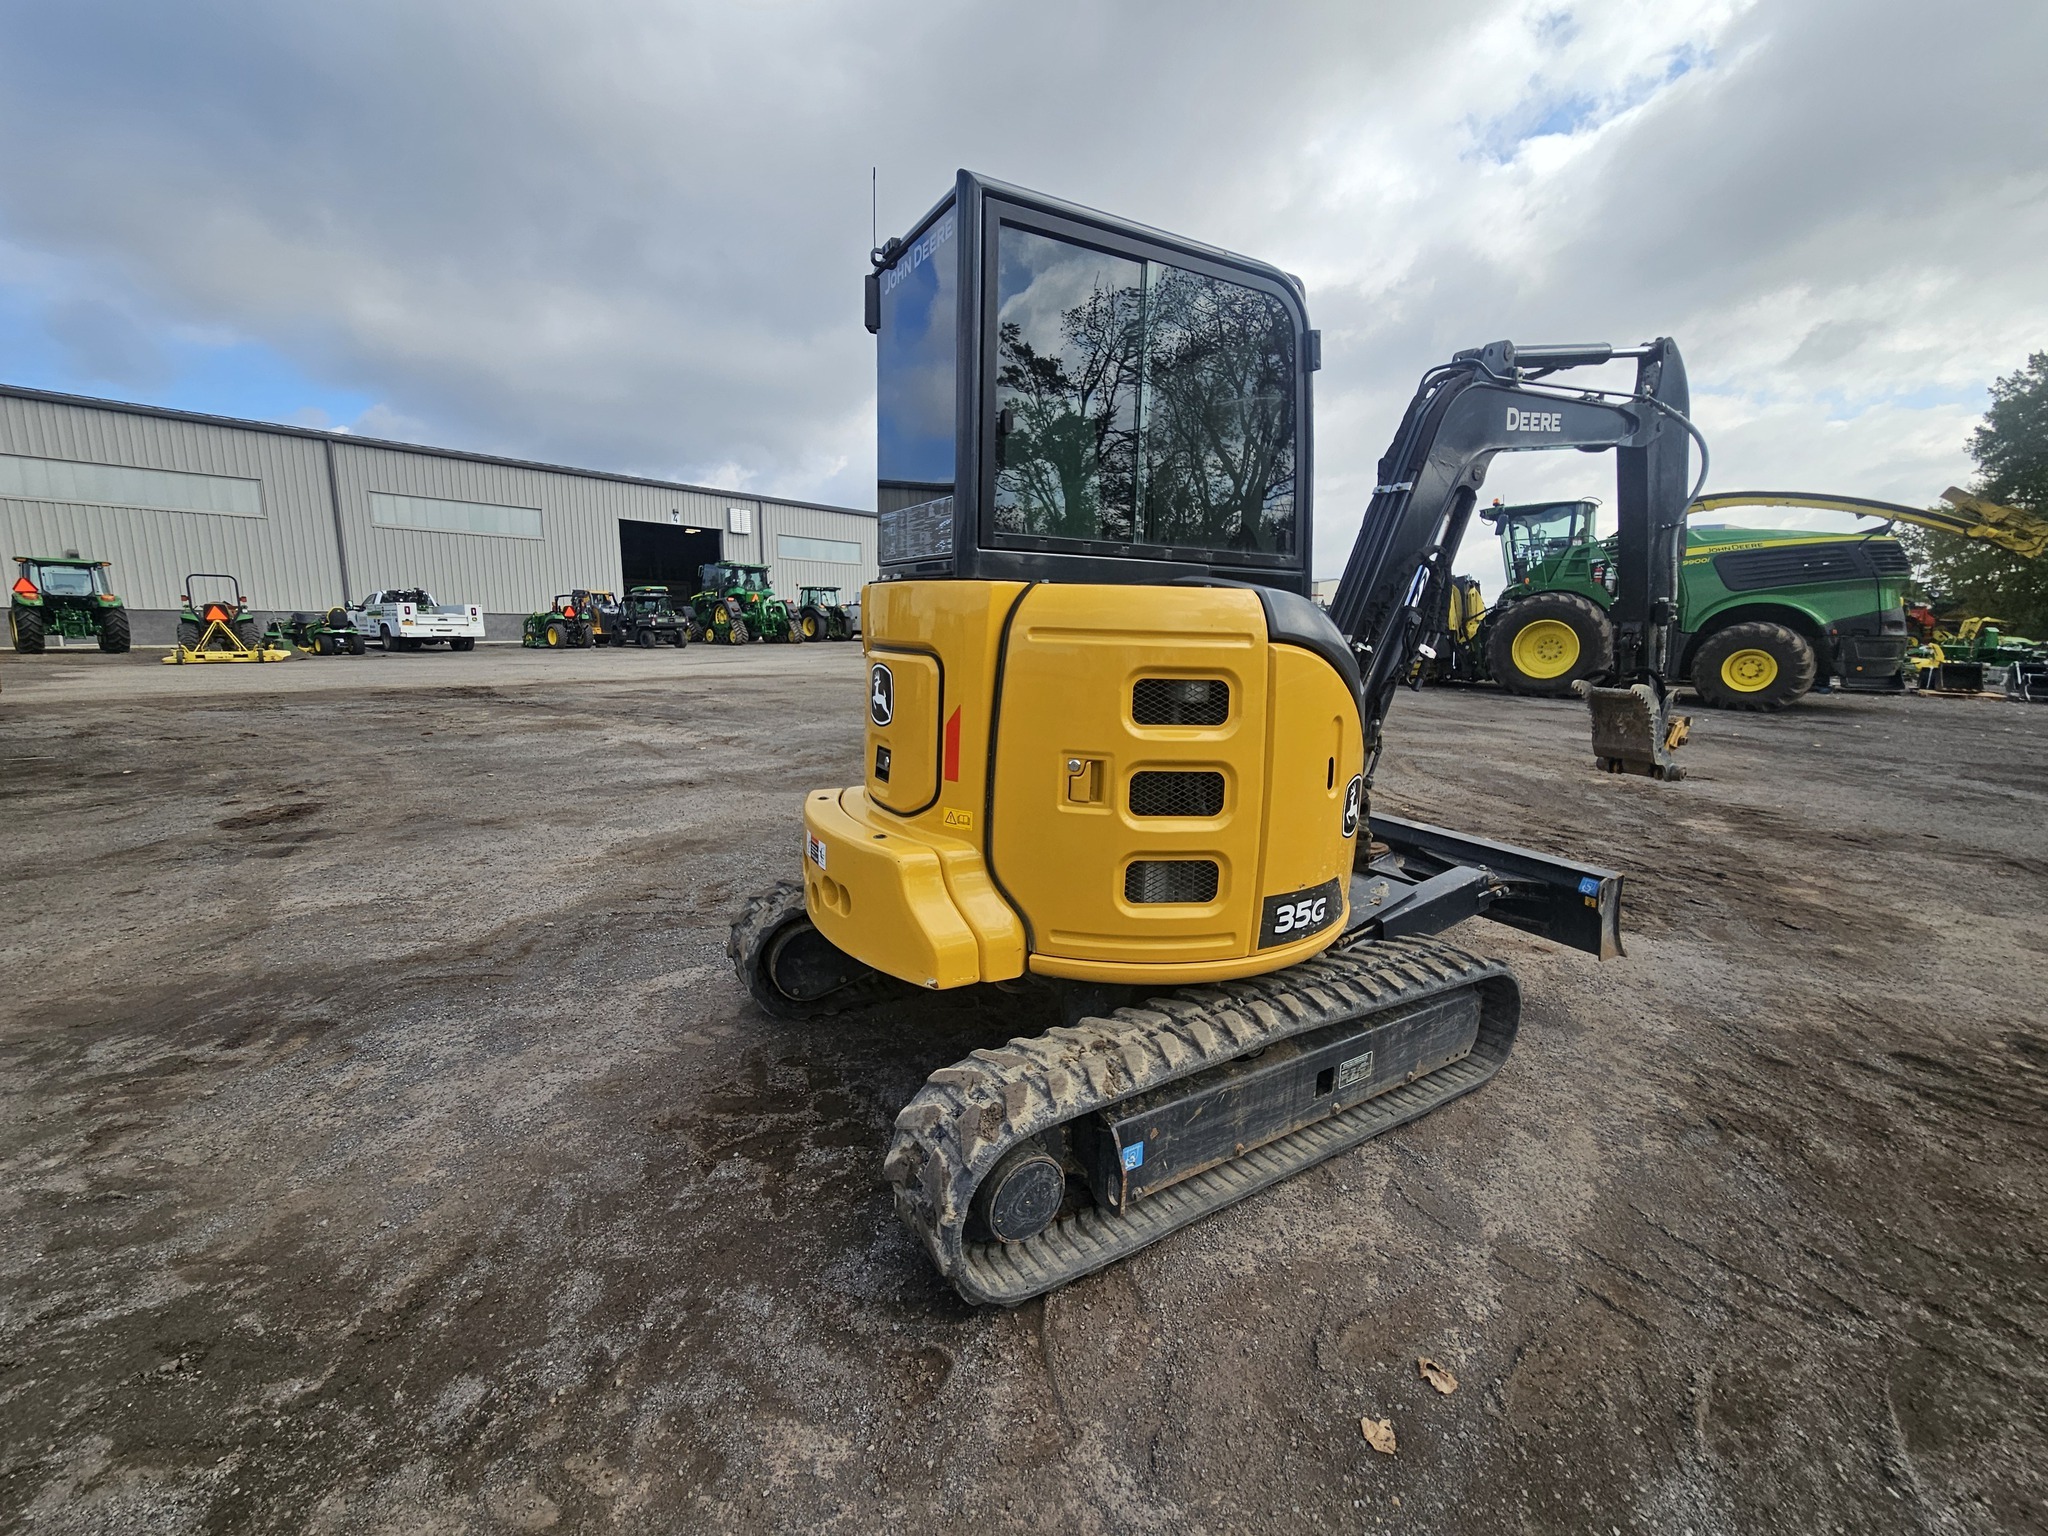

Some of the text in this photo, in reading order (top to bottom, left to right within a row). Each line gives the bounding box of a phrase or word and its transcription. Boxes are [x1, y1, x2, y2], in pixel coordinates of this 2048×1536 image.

[885, 216, 954, 295] JOHN DEERE
[1506, 407, 1562, 432] DEERE
[1731, 542, 1764, 551] DEERE
[1274, 897, 1327, 934] 35G
